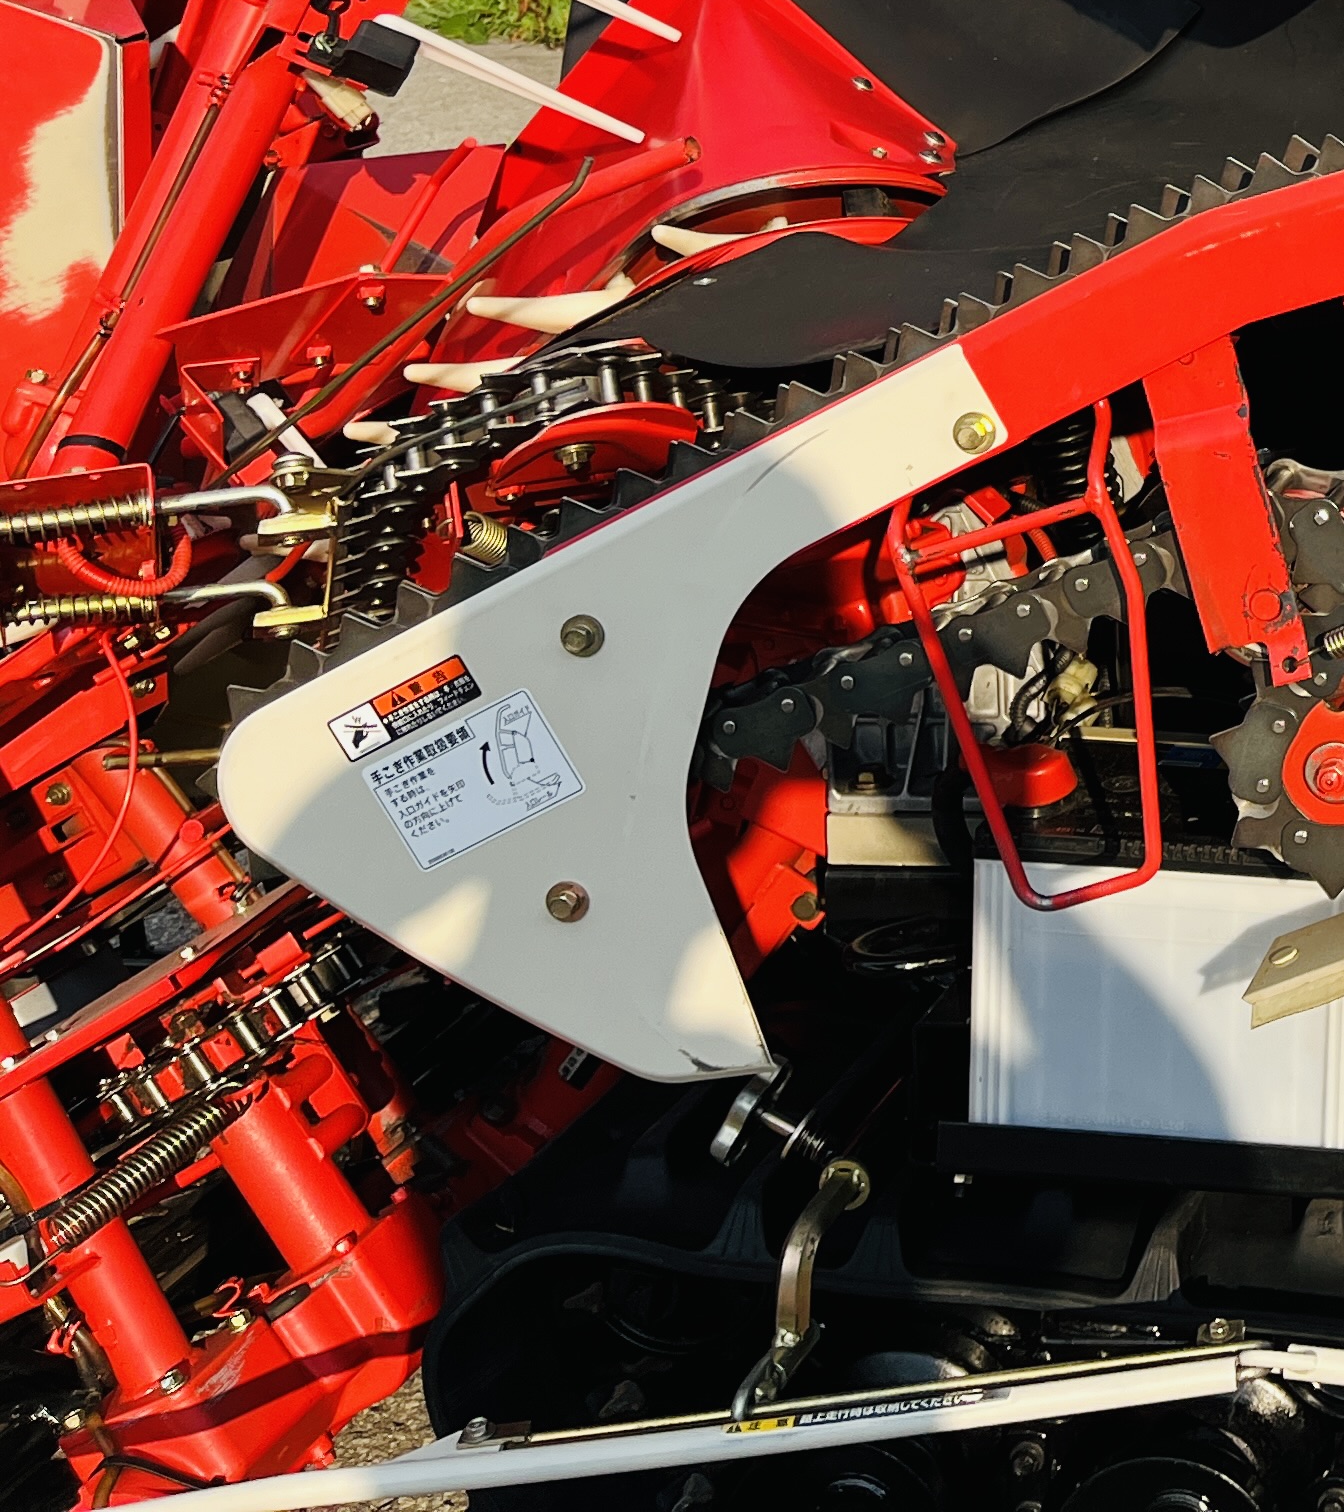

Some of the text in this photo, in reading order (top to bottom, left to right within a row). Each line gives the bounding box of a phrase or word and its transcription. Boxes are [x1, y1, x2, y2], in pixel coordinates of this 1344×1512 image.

[370, 725, 471, 785] 手こぎ作業取扱要領
[384, 767, 436, 798] 手こぎ作業を
[398, 778, 466, 820] 入口ガイドを矢印
[404, 793, 463, 829] の方向に上げて
[411, 818, 450, 837] ください。
